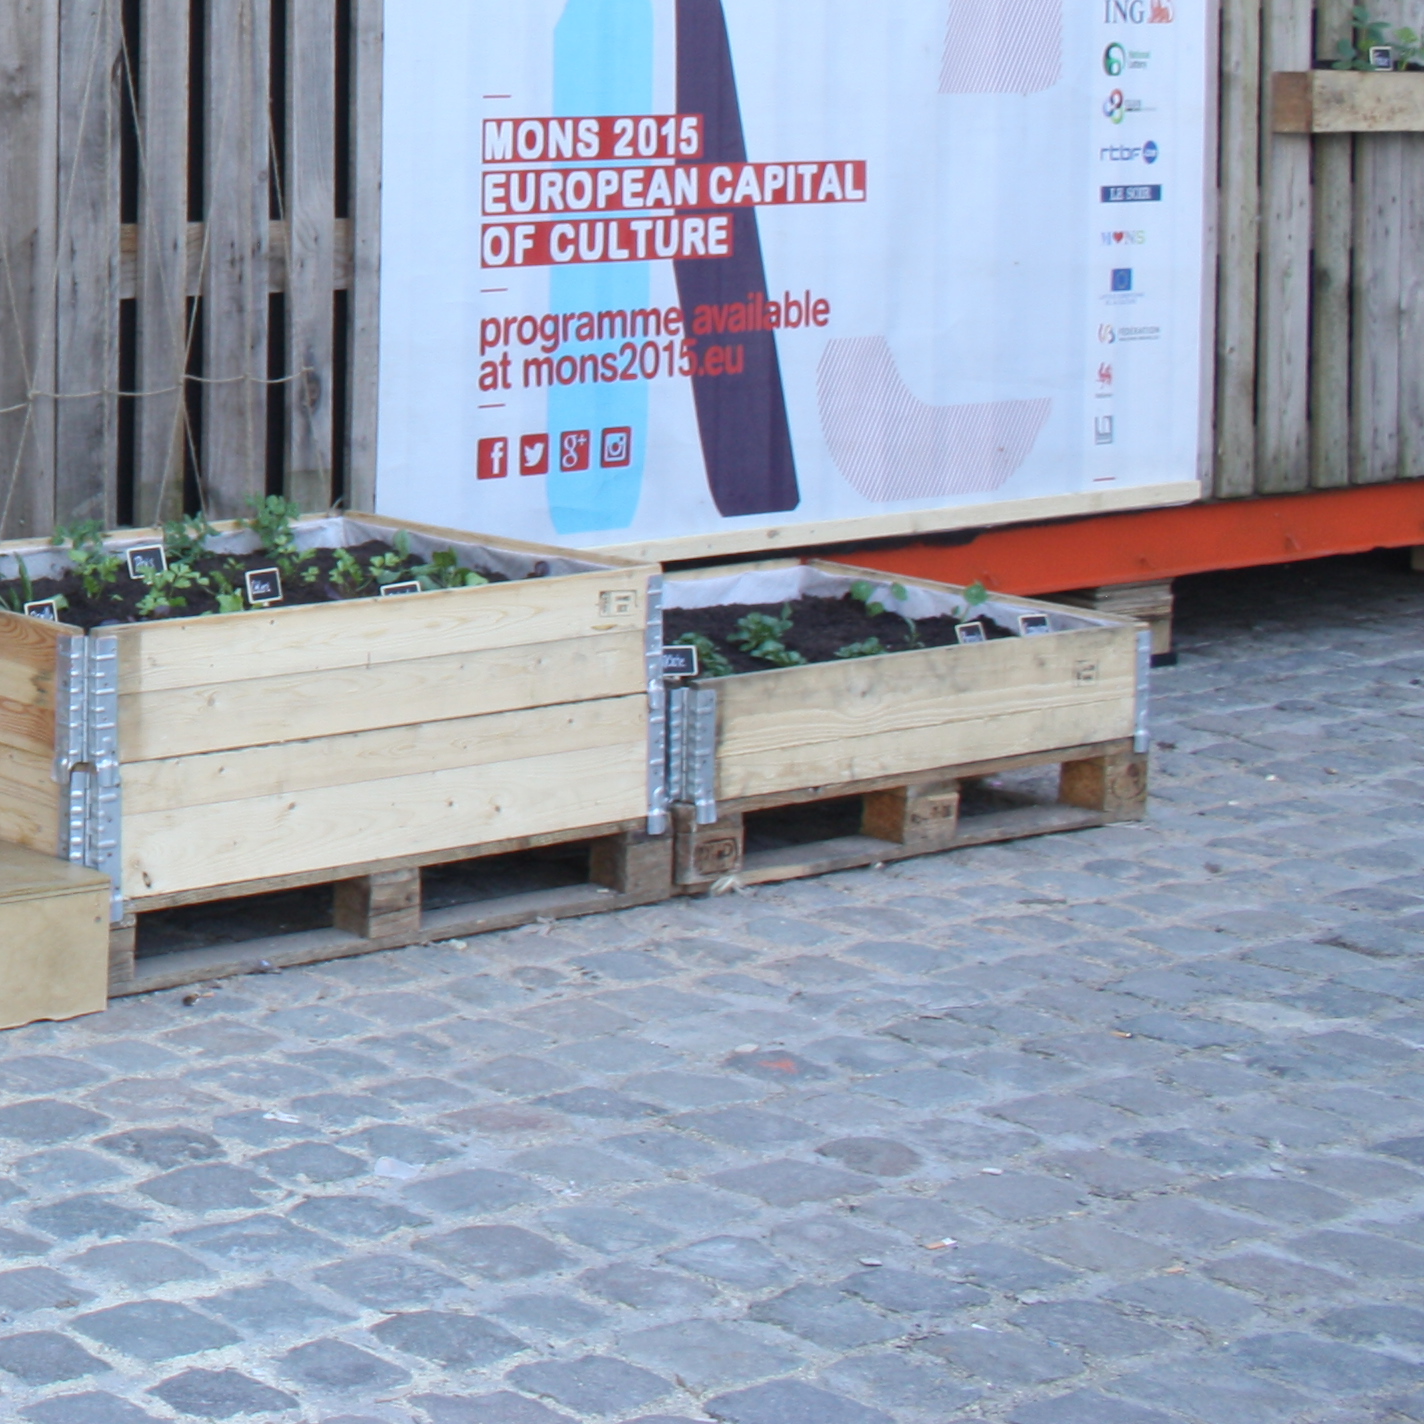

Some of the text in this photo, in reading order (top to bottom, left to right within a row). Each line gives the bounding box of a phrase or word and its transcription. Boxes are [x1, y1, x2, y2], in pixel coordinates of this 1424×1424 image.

[1104, 0, 1145, 24] ING
[484, 117, 699, 160] MONS 2015
[484, 163, 864, 213] EUROPEAN CAPITAL
[483, 216, 729, 266] OF CULTURE
[480, 290, 830, 357] programme available
[479, 339, 745, 391] at mons2015.eu
